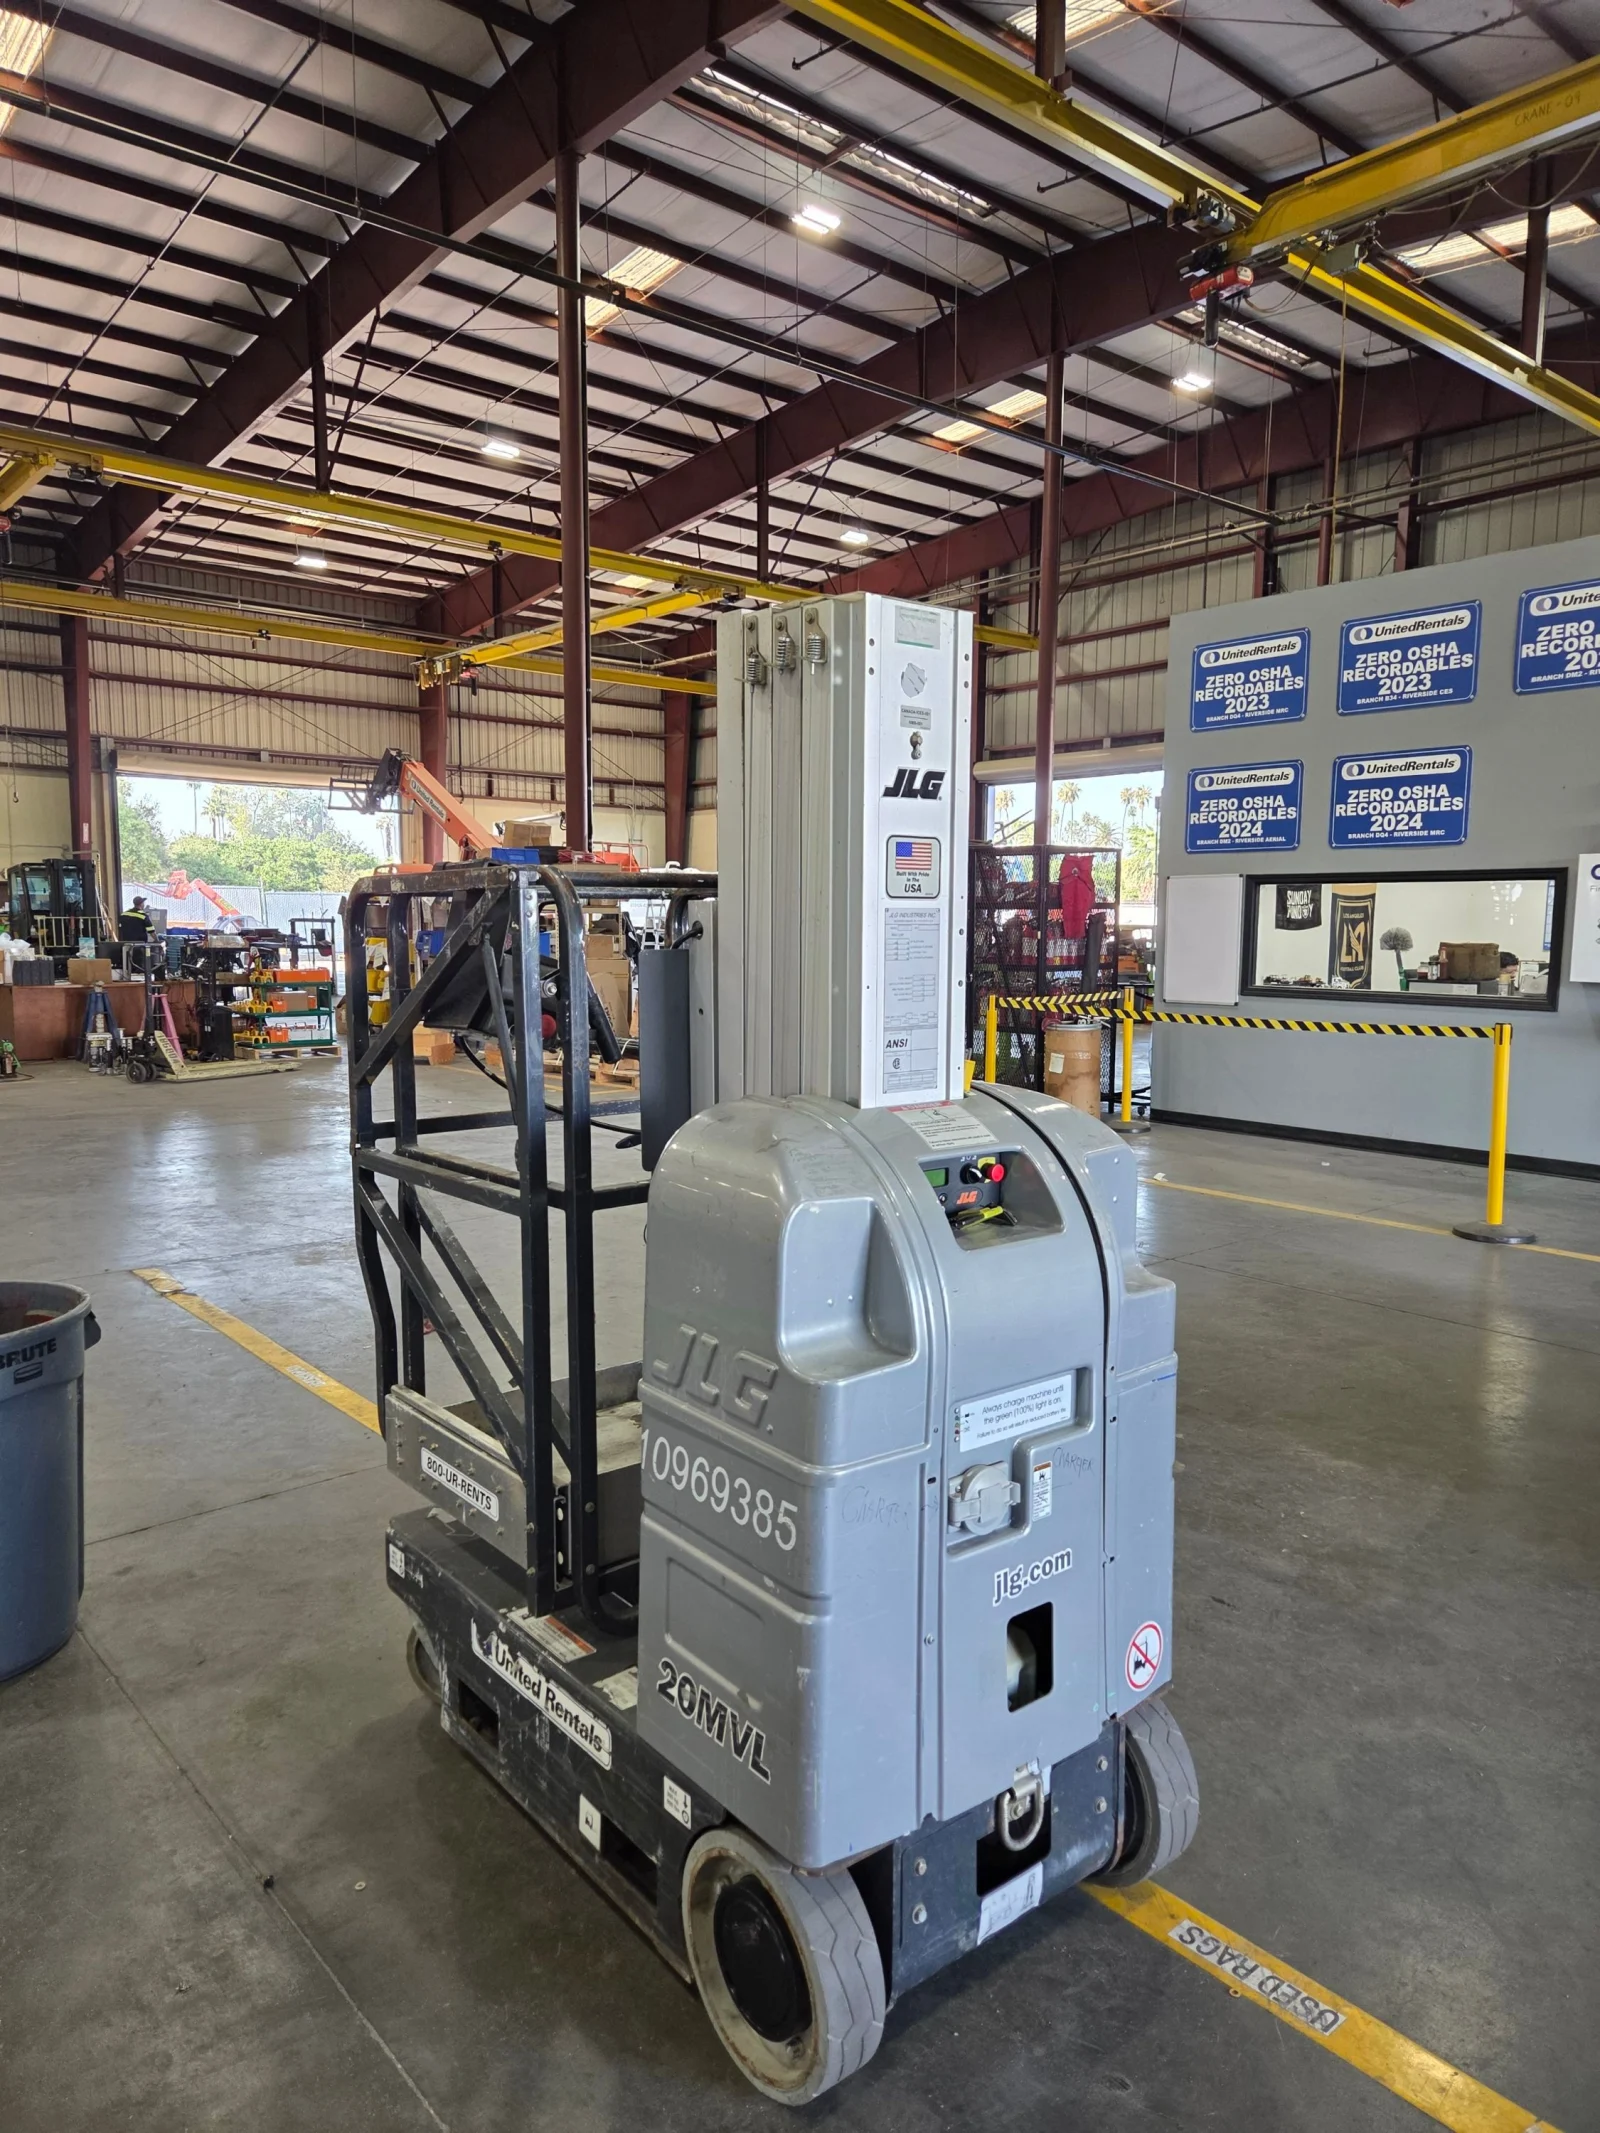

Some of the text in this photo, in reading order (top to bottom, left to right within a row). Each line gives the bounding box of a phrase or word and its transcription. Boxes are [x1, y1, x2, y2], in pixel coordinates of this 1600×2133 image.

[1374, 615, 1465, 637] UnitedRentals
[1536, 620, 1595, 641] ZERO
[1221, 641, 1297, 661] UnitedRentals
[1355, 642, 1459, 668] ZERO OSHA
[1564, 650, 1600, 671] 20
[1205, 665, 1292, 689] ZERO OSHA
[1343, 653, 1473, 683] RECORDABLES
[1531, 673, 1564, 683] BRANCH
[1565, 671, 1583, 679] DM2
[1195, 676, 1304, 702] RECORDABLES
[1378, 673, 1431, 695] 2023
[1224, 694, 1270, 714] 2023
[1357, 696, 1383, 705] BRANCH
[1402, 689, 1438, 699] RIVERSIDE
[1206, 714, 1229, 722] BRANCH
[1245, 709, 1275, 718] RIVERSIDE
[1366, 758, 1455, 774] UnitedRentals
[882, 769, 946, 799] JLG
[1215, 771, 1289, 786] UnitedRentals
[1200, 795, 1285, 811] ZERO OSHA
[1347, 784, 1449, 803] ZERO OSHA
[1190, 807, 1297, 824] RECORDABLES
[1336, 797, 1463, 816] RECORDABLES
[1219, 822, 1263, 838] 2024
[1370, 813, 1423, 832] 2024
[904, 884, 921, 893] USA
[1287, 890, 1312, 905] SUNDAY
[885, 1038, 908, 1049] ANSI
[956, 1190, 978, 1205] JLG
[652, 1323, 779, 1430] JLG
[982, 1384, 1064, 1415] Always charge machine until
[983, 1416, 994, 1425] the
[995, 1410, 1013, 1423] green
[1035, 1400, 1047, 1411] light
[426, 1456, 492, 1511] 800-UR-RENTS
[640, 1428, 798, 1551] 10969385
[993, 1549, 1072, 1606] jlg.com
[495, 1648, 542, 1700] United
[545, 1686, 603, 1753] Rentals
[657, 1657, 771, 1785] 20MVL
[1178, 1926, 1340, 2033] USED RAGS
